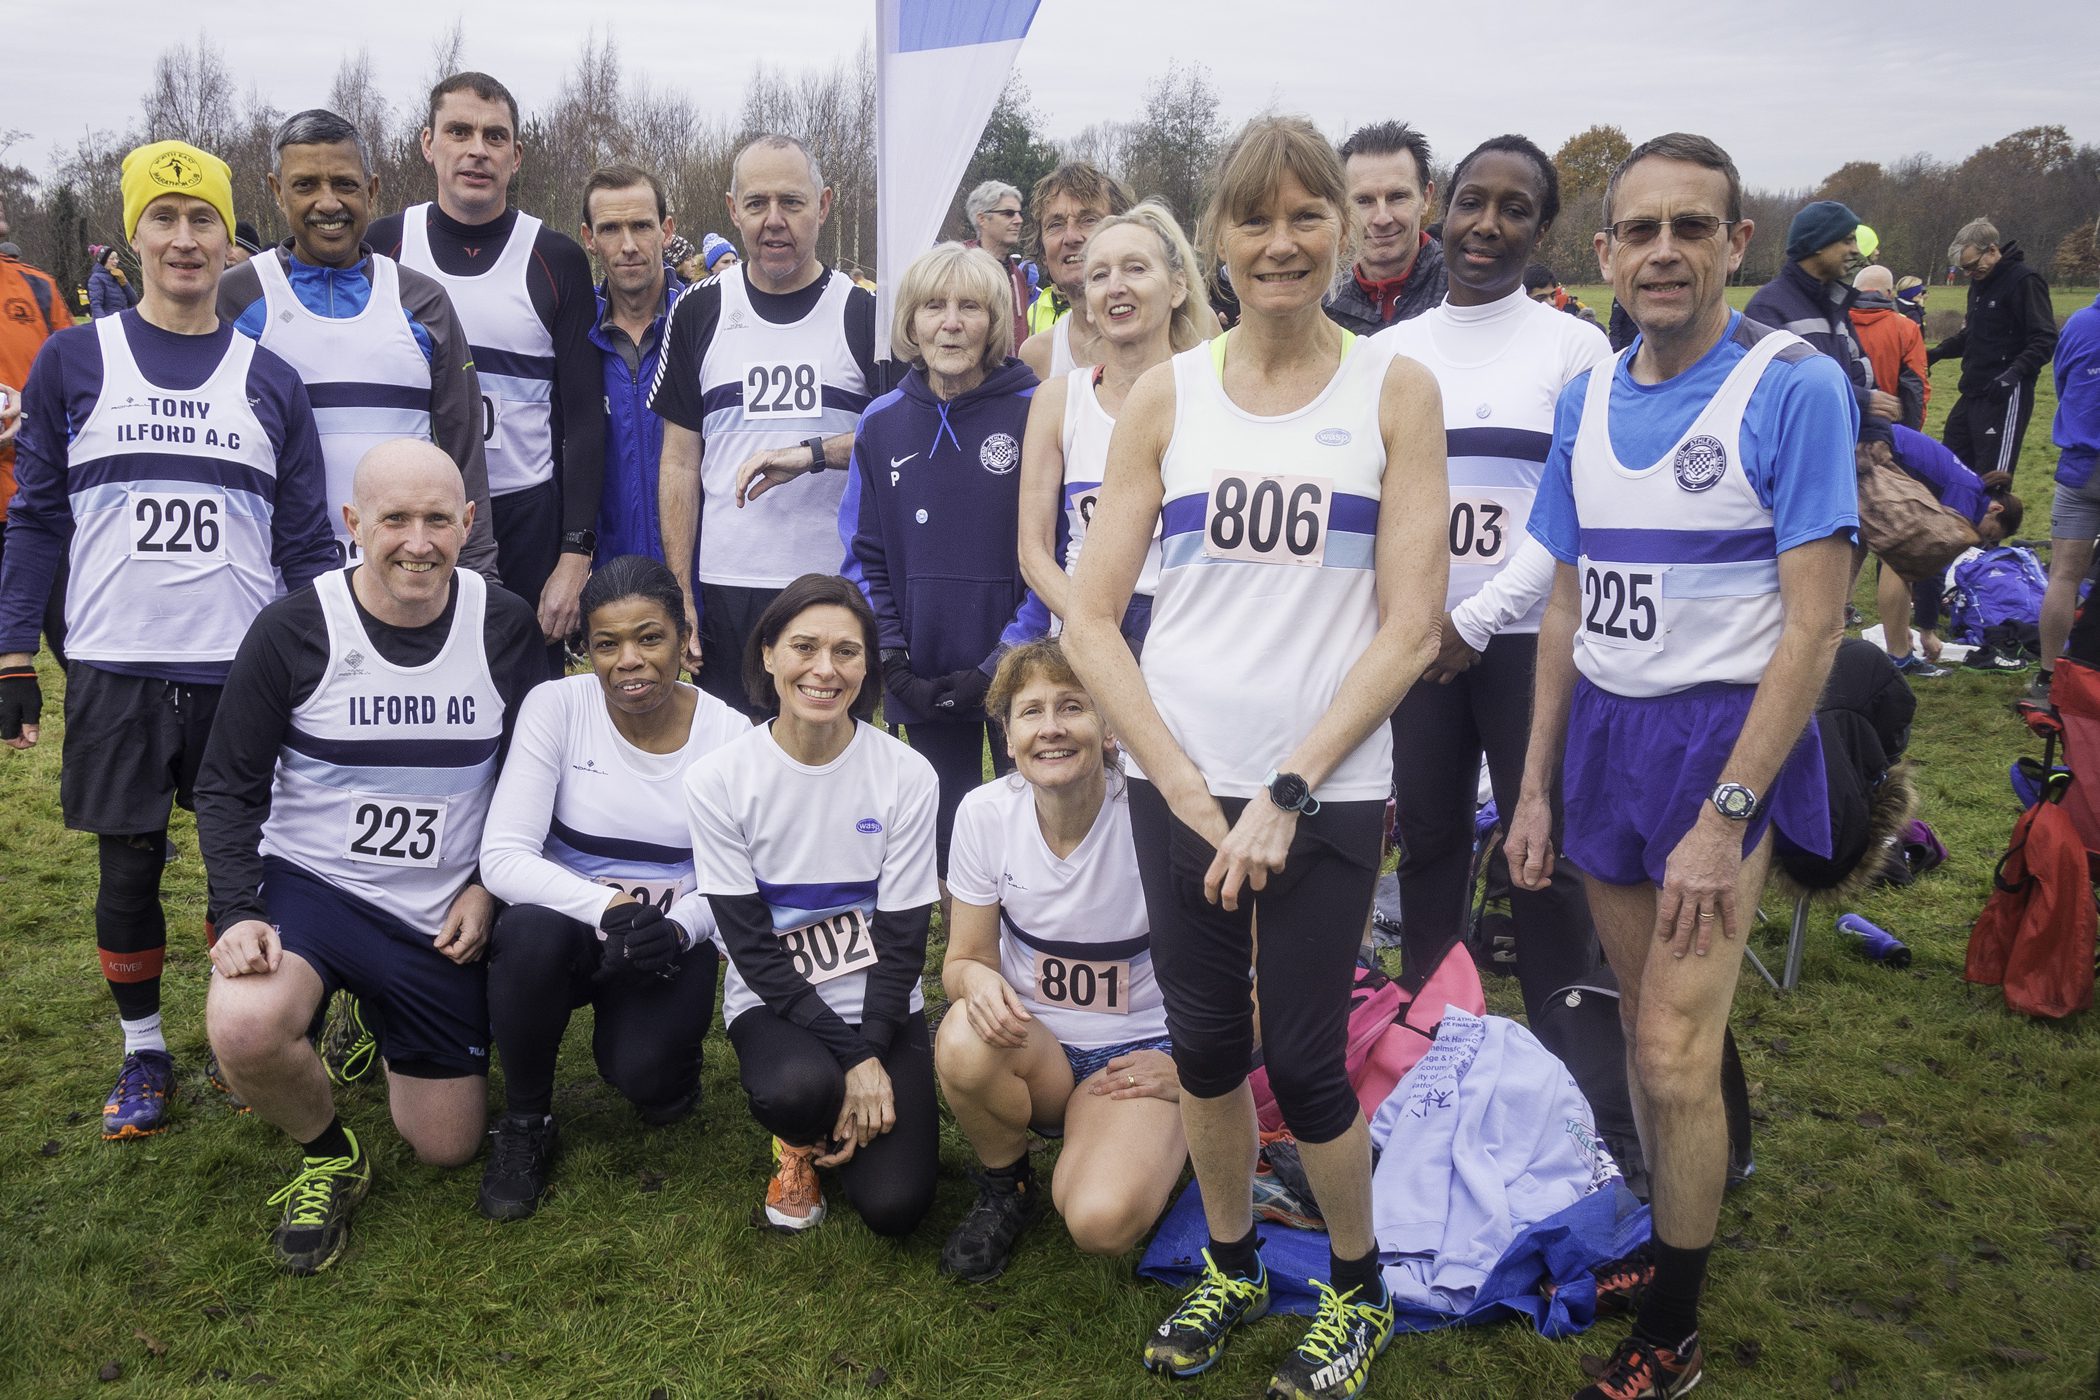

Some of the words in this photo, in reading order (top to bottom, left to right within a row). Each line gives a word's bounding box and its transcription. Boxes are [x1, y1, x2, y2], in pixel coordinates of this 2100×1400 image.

[147, 397, 210, 420] TONY
[747, 363, 817, 413] 228
[117, 423, 196, 444] ILFORD
[205, 428, 241, 450] A.C
[890, 471, 900, 487] P
[136, 498, 219, 553] 226
[1210, 477, 1322, 556] 806
[1585, 567, 1657, 641] 225
[349, 695, 436, 726] ILFORD
[446, 695, 476, 725] AC
[350, 803, 439, 860] 223
[109, 961, 137, 972] ACTIVE
[778, 910, 870, 980] 802
[1041, 958, 1118, 1008] 801
